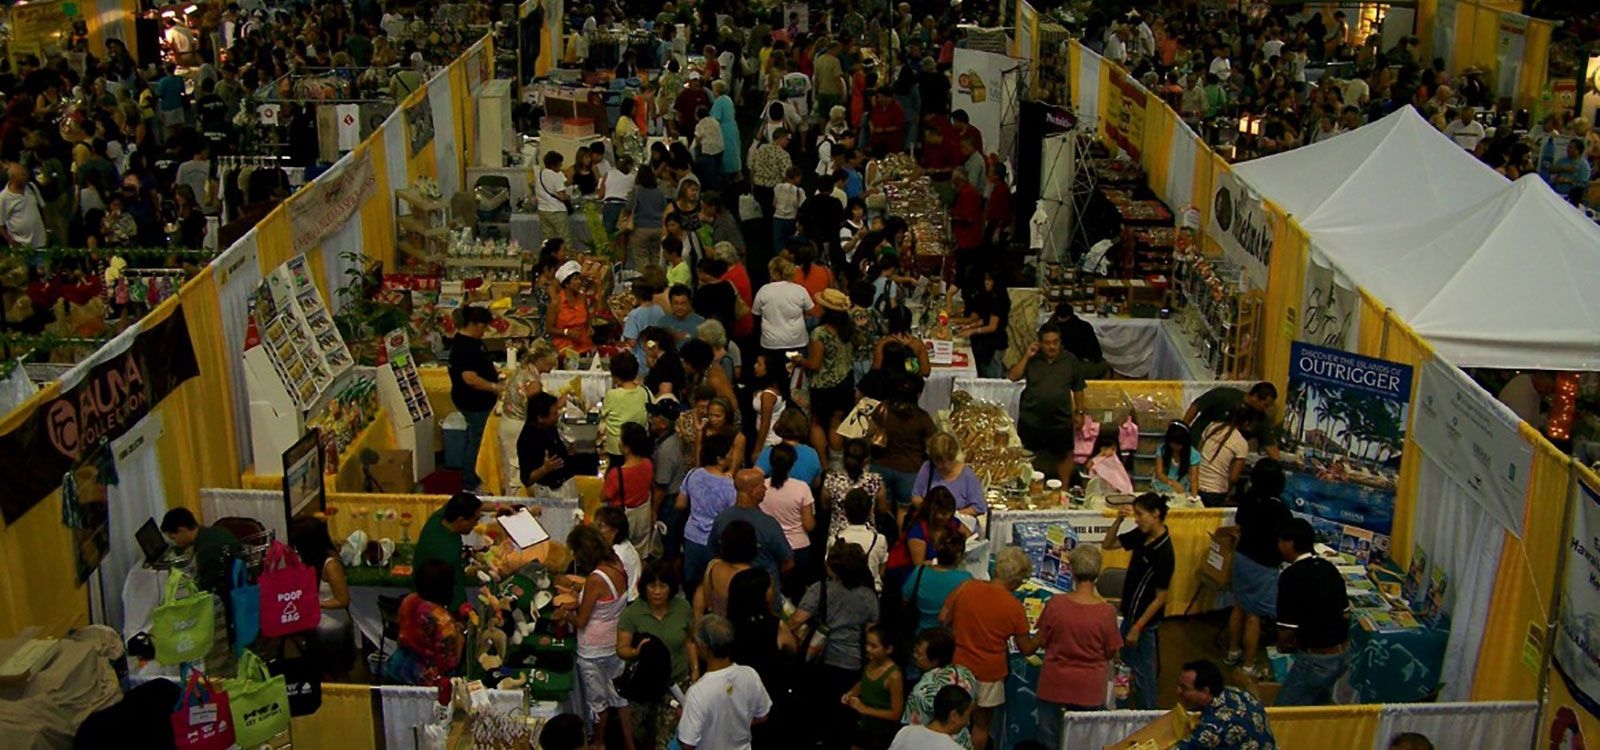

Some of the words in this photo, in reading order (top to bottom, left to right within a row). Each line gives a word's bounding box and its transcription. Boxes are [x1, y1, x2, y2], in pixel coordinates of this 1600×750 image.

[1300, 348, 1339, 364] DISCOVER
[1339, 356, 1355, 367] THE
[1356, 359, 1389, 374] ISLANDS
[1389, 367, 1403, 376] OF
[1298, 356, 1401, 393] OUTRIGGER
[277, 589, 302, 602] POOP
[281, 613, 301, 624] BAG
